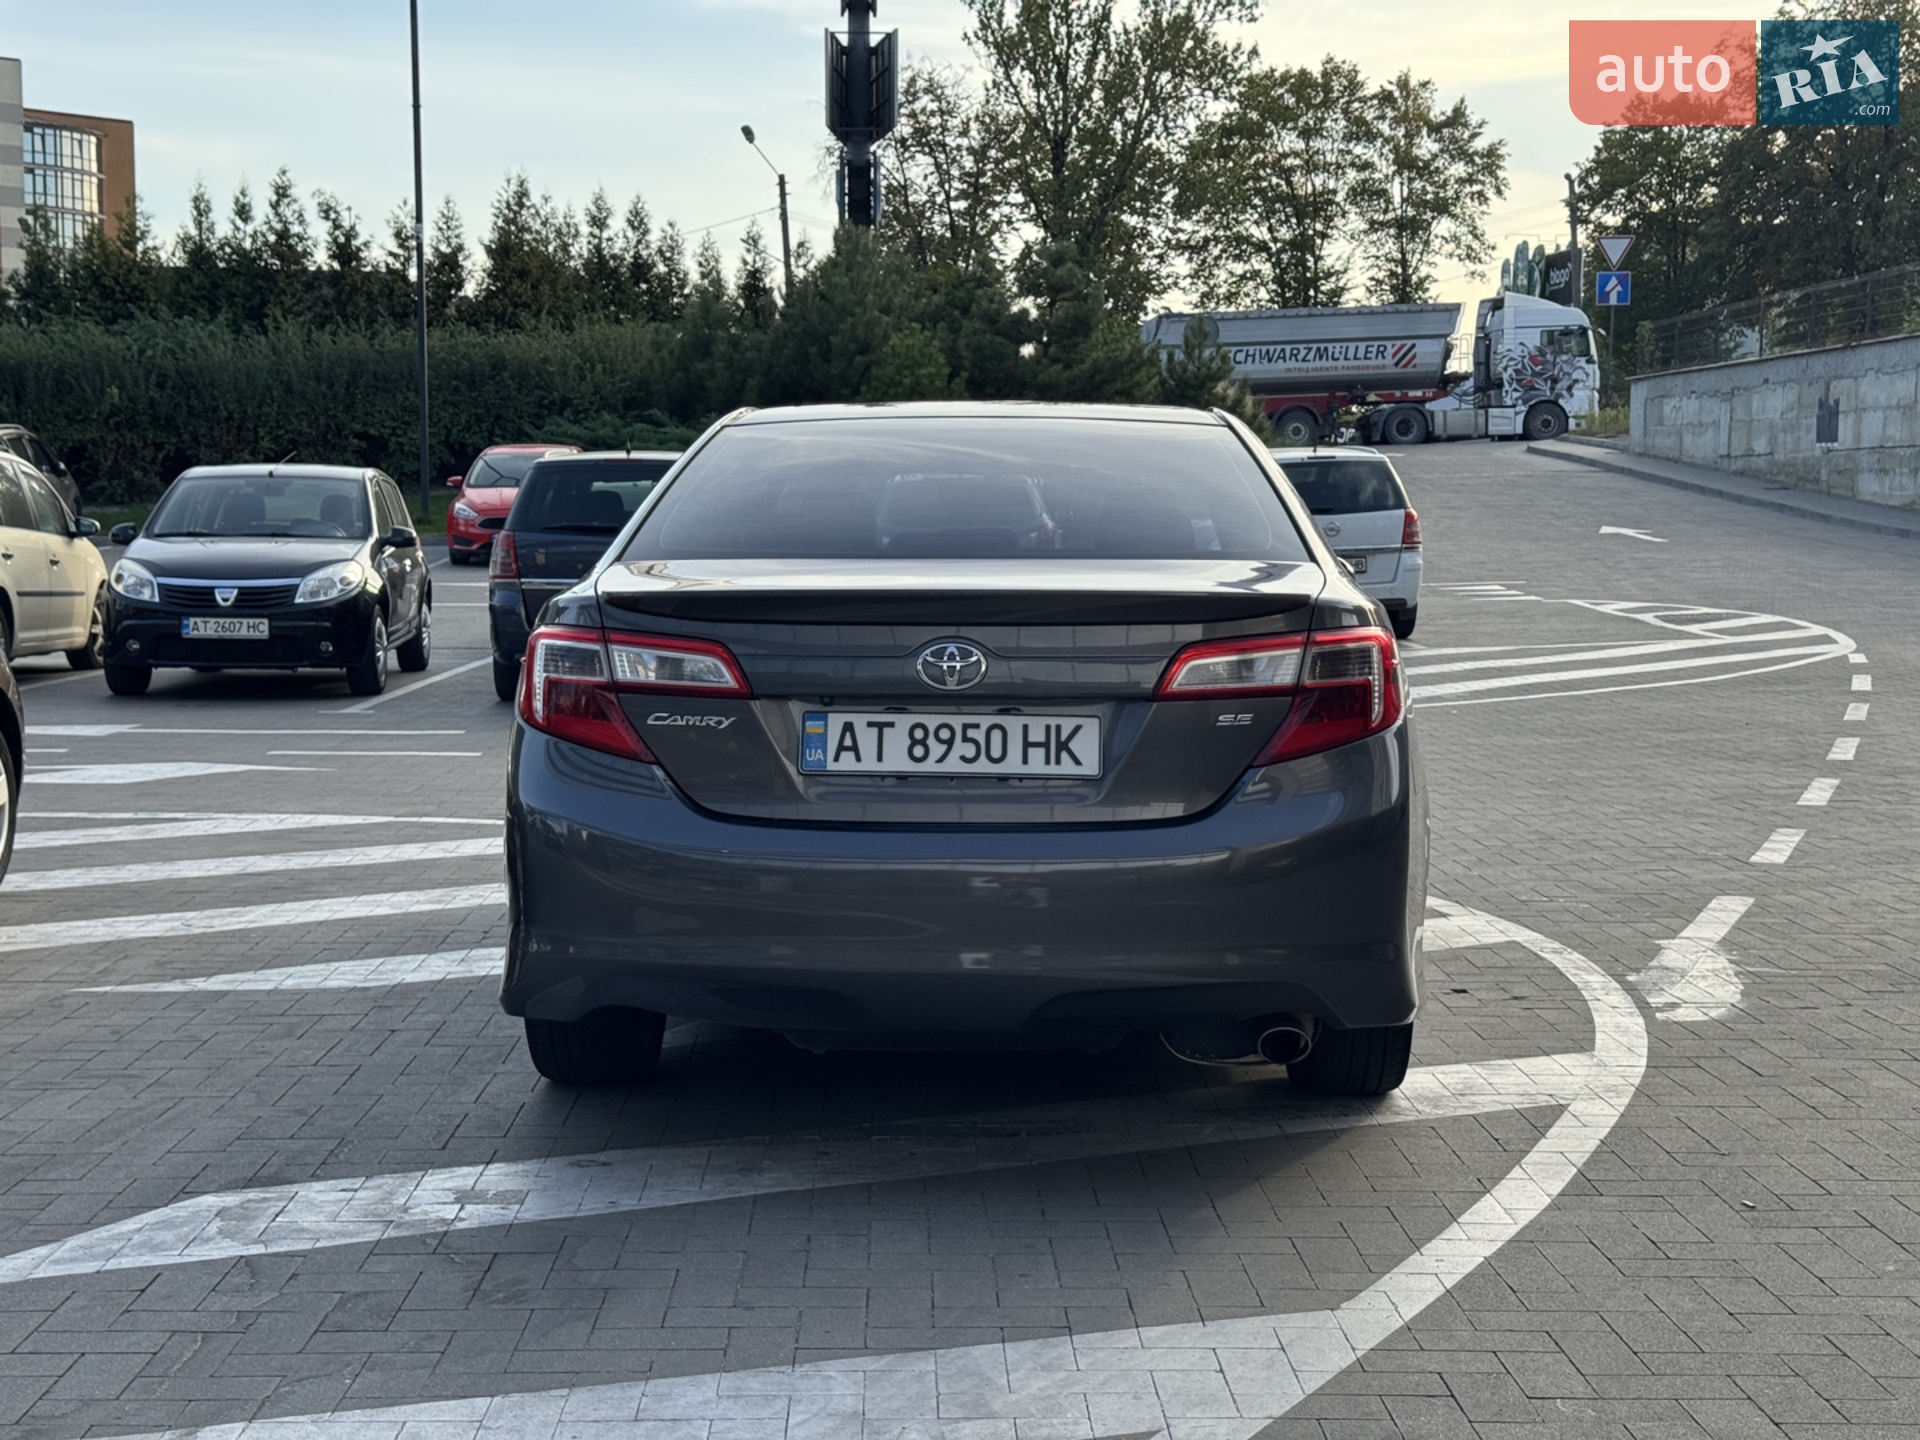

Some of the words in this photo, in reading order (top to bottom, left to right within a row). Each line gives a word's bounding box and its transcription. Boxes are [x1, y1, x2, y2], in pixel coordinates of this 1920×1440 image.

[1231, 344, 1387, 365] CHWARZMÜLLER
[191, 620, 210, 633] AT
[213, 620, 244, 634] 2607
[246, 621, 266, 634] HC
[646, 712, 738, 730] CAMRY
[1215, 714, 1255, 726] SE
[833, 721, 896, 763] AT
[906, 722, 1008, 765] 8950
[1021, 724, 1084, 766] HK
[806, 747, 824, 761] UA
